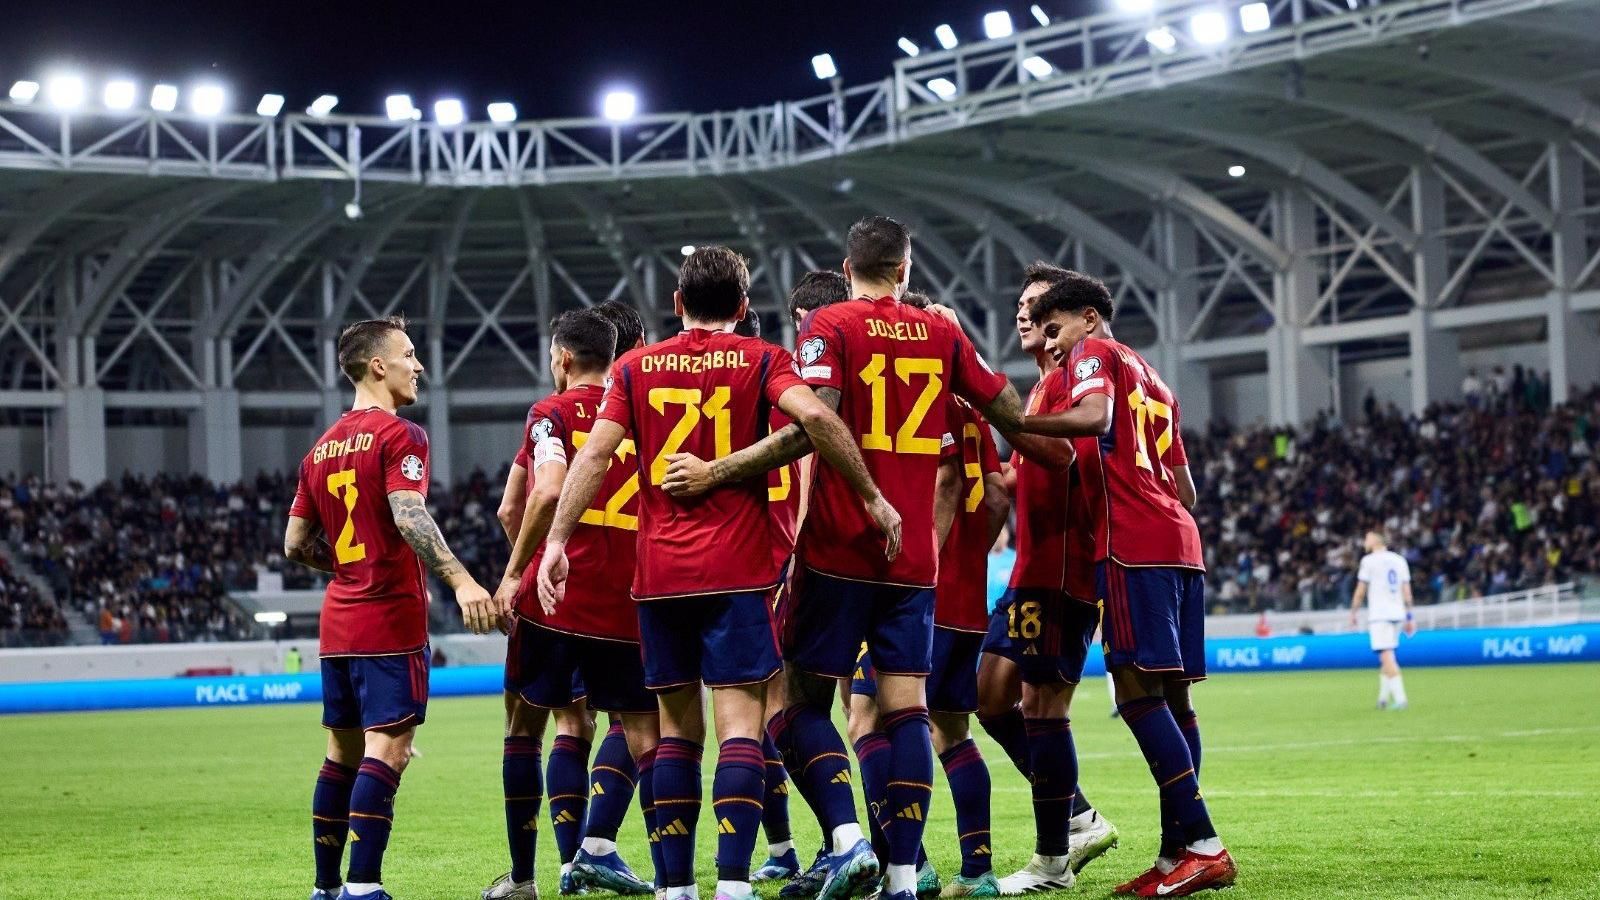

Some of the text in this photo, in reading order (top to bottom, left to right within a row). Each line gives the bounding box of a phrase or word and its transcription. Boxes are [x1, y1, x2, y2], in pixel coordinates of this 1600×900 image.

[865, 318, 929, 341] JOSELU
[641, 349, 750, 374] OYARZABAL
[858, 353, 943, 455] 12
[313, 432, 374, 465] GRIMALDO
[648, 386, 732, 486] 21
[326, 468, 367, 565] 2
[1007, 600, 1042, 639] 18
